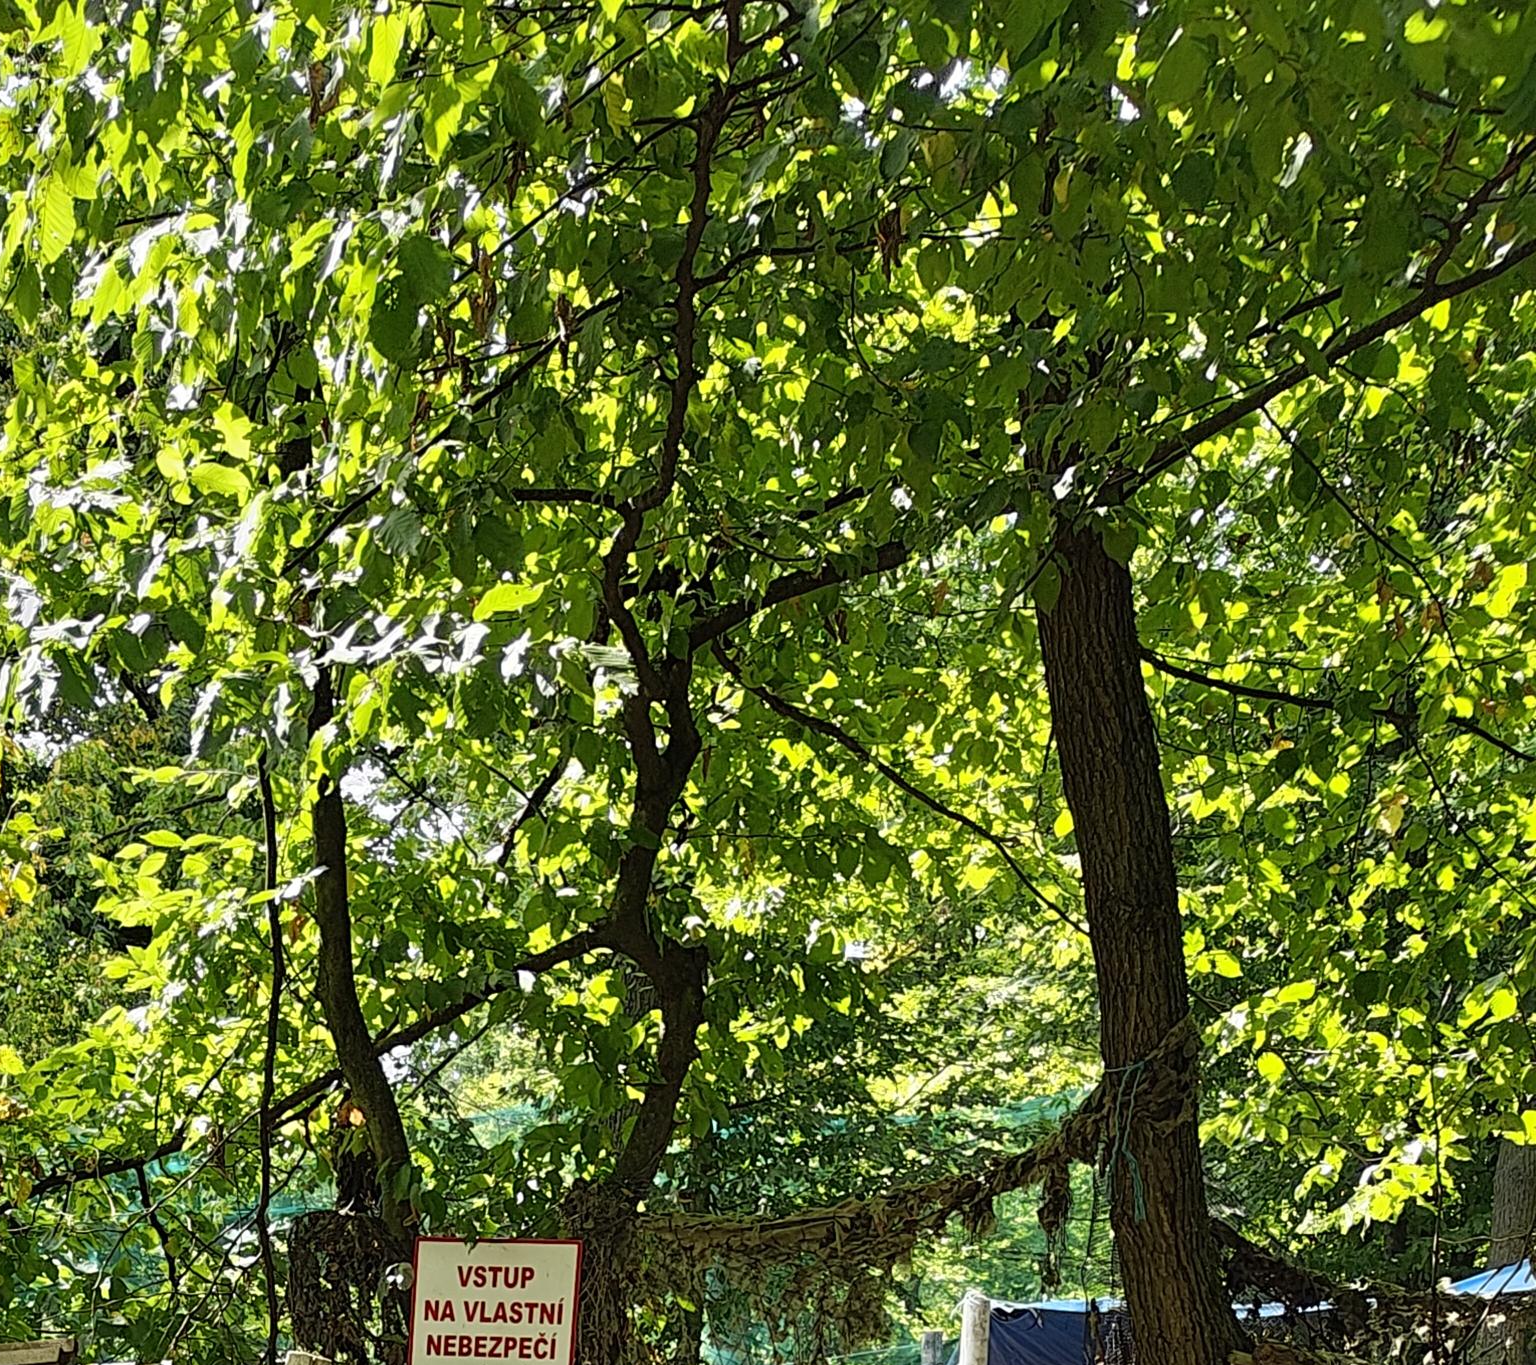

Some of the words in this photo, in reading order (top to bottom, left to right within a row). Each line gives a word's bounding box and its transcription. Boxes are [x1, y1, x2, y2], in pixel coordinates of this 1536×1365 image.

[457, 1266, 535, 1289] VSTUP
[424, 1299, 455, 1322] NA
[463, 1297, 565, 1325] VLASTNÍ
[426, 1332, 557, 1360] NEBEZPEČÍ
